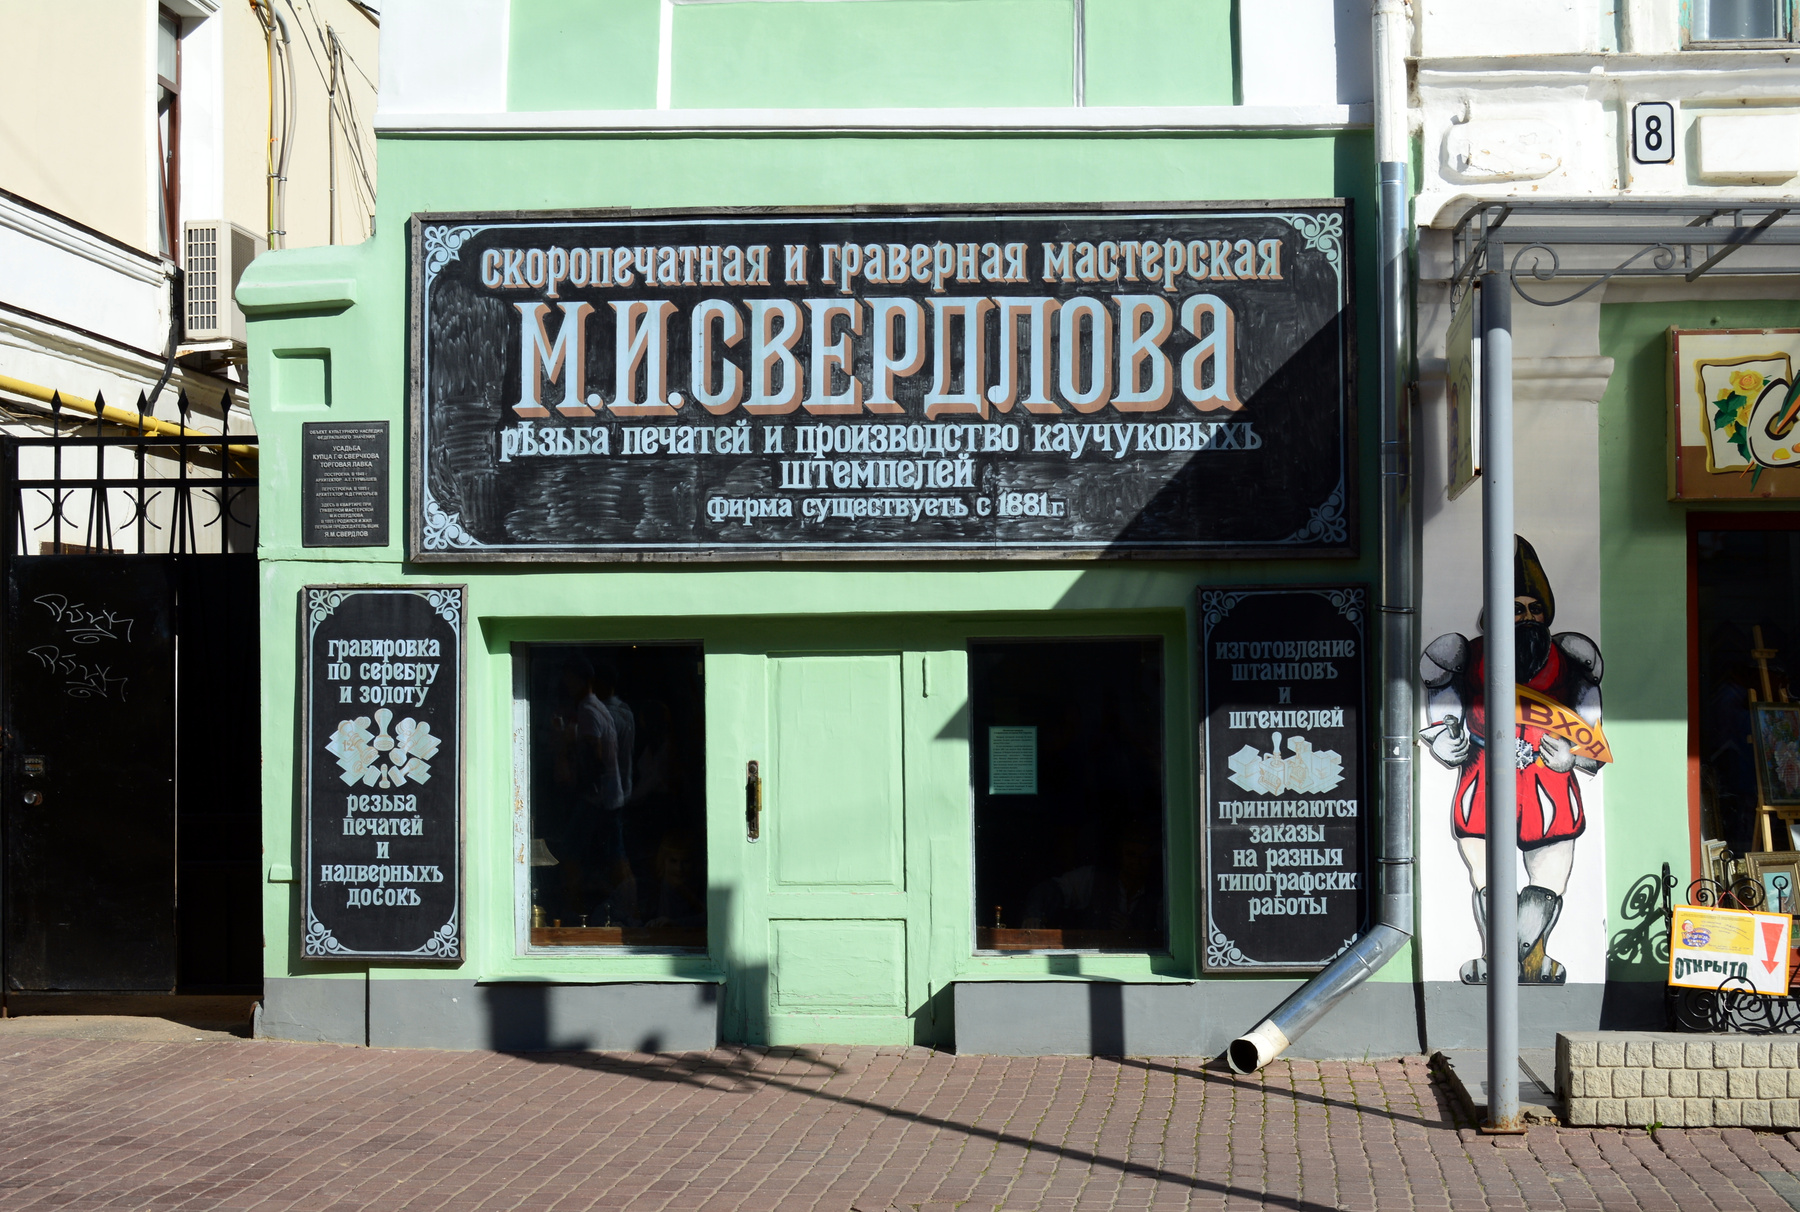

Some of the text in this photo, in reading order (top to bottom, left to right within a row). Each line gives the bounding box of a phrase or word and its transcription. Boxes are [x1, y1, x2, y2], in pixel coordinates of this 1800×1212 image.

[1645, 115, 1663, 151] 8
[481, 238, 1284, 298] скоропечатная и граверная мастерская
[621, 418, 753, 455] печатей
[763, 425, 785, 454] и
[795, 422, 1019, 458] производство
[1031, 421, 1263, 459] каучуковыхъ
[778, 453, 975, 490] штемпелей
[976, 496, 992, 516] с
[327, 637, 441, 663] гравировка
[1215, 640, 1356, 662] изготовление
[327, 662, 440, 686] по серебру
[1231, 662, 1339, 681] штамповъ
[339, 685, 429, 707] и золоту
[1278, 686, 1292, 704] и
[1228, 706, 1345, 731] штемпелей
[1518, 695, 1605, 758] ВХОД
[346, 793, 417, 818] резьба
[1218, 799, 1359, 825] принимаются
[342, 814, 424, 836] печатей
[1249, 823, 1326, 844] заказы
[376, 841, 390, 859] и
[1232, 847, 1343, 873] на разныя
[320, 864, 444, 888] надверныхъ
[1217, 871, 1363, 897] типографския
[346, 887, 422, 909] досокъ
[1248, 896, 1328, 922] работы
[1674, 957, 1748, 984] ОТКРЫТО
